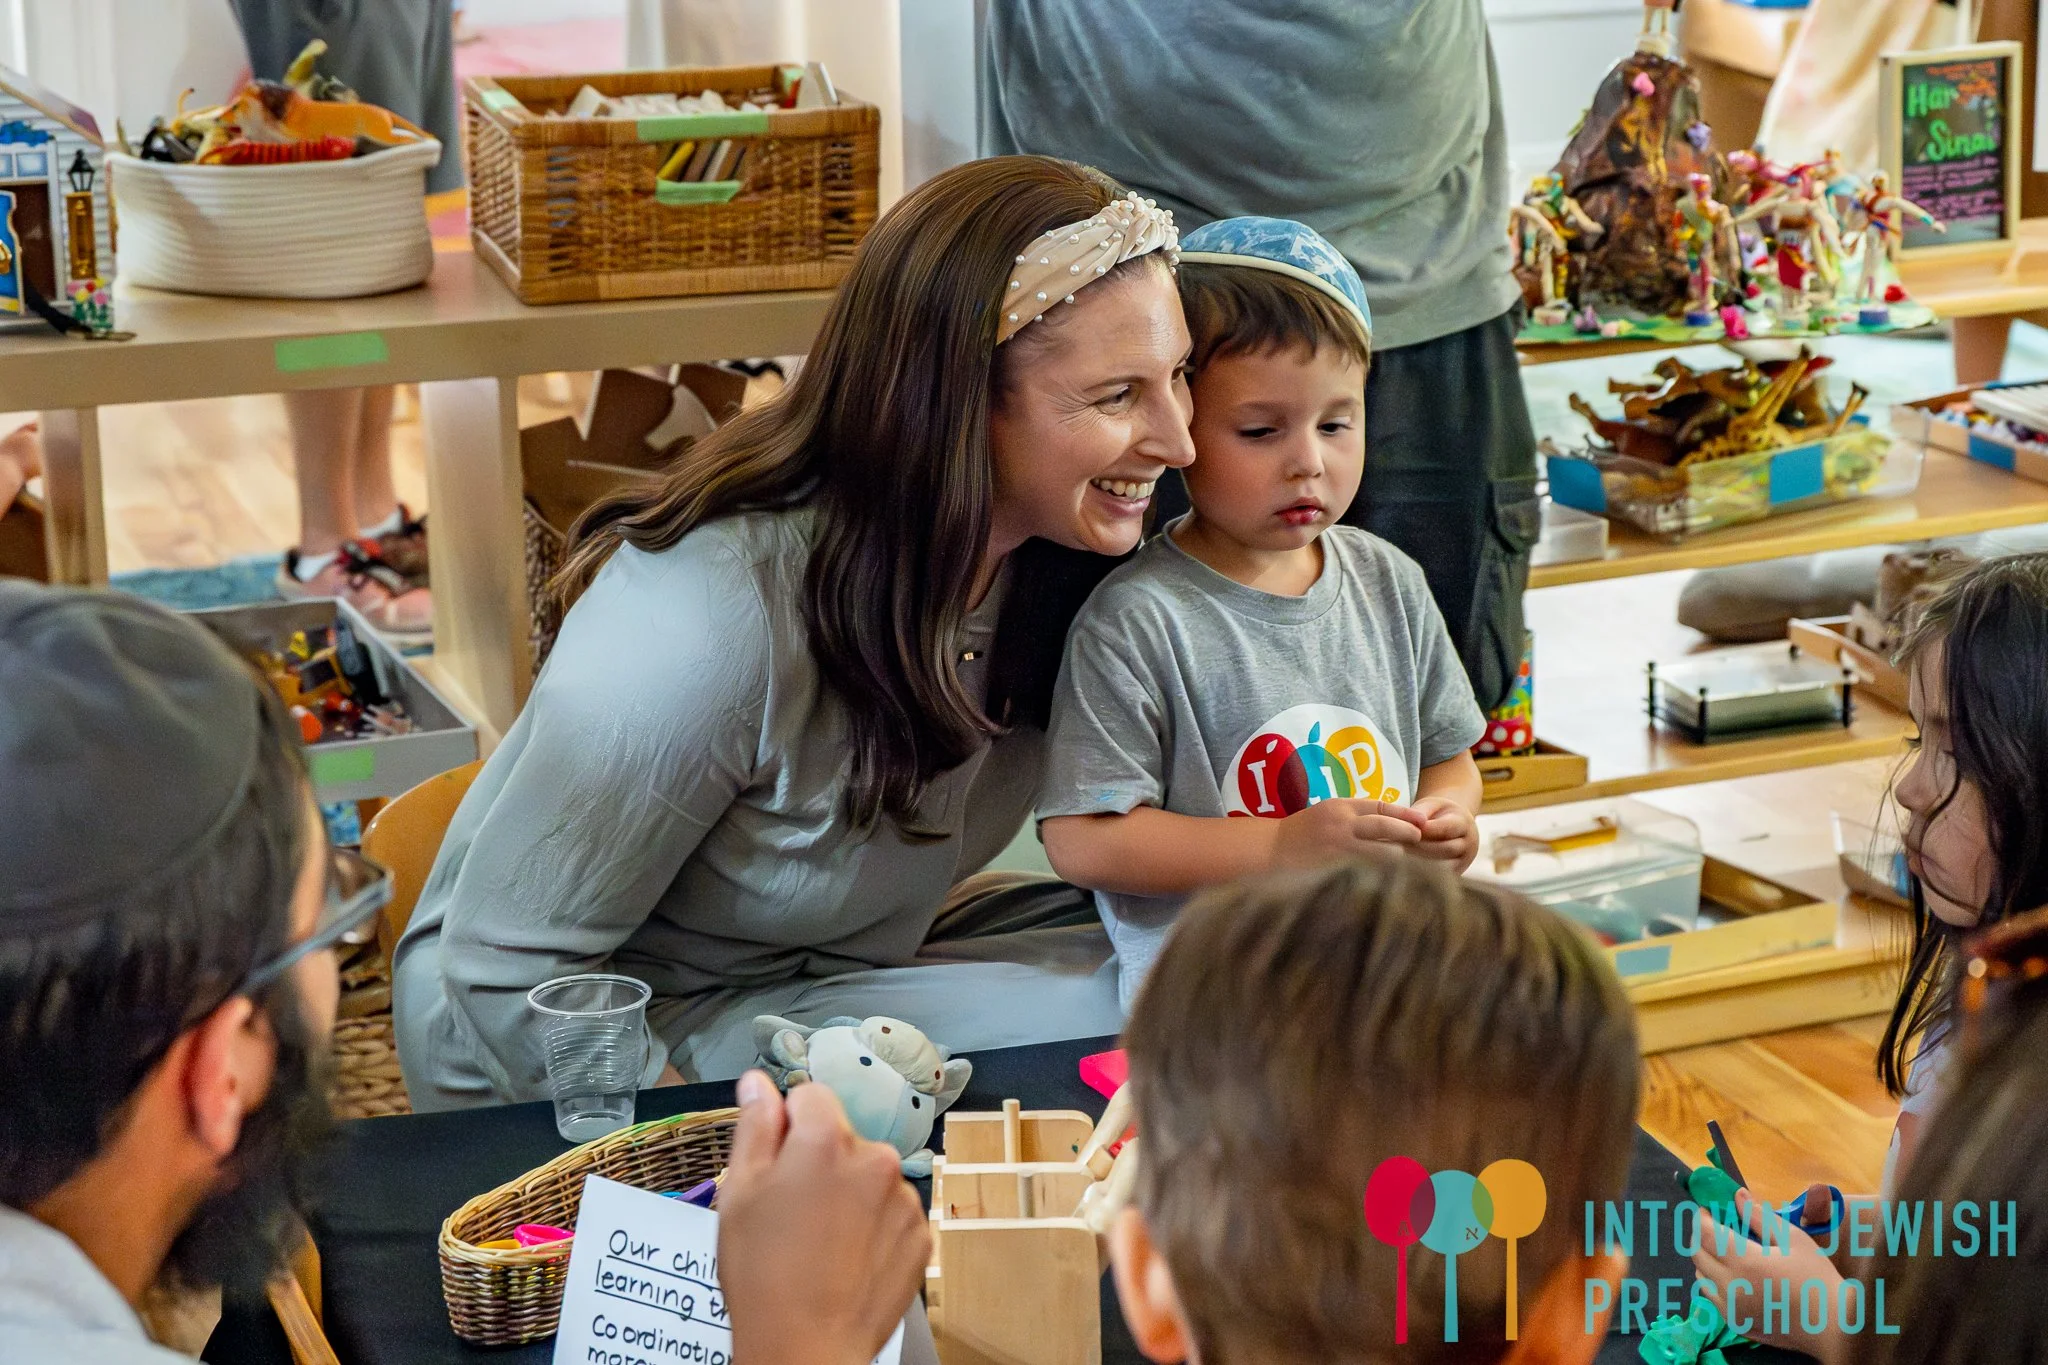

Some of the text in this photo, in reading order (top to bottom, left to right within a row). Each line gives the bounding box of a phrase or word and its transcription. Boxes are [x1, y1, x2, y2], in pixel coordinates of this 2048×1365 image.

[1907, 82, 1959, 117] Har
[1926, 119, 1997, 162] Sinai
[609, 1229, 717, 1280] Our chil
[595, 1259, 695, 1321] learning
